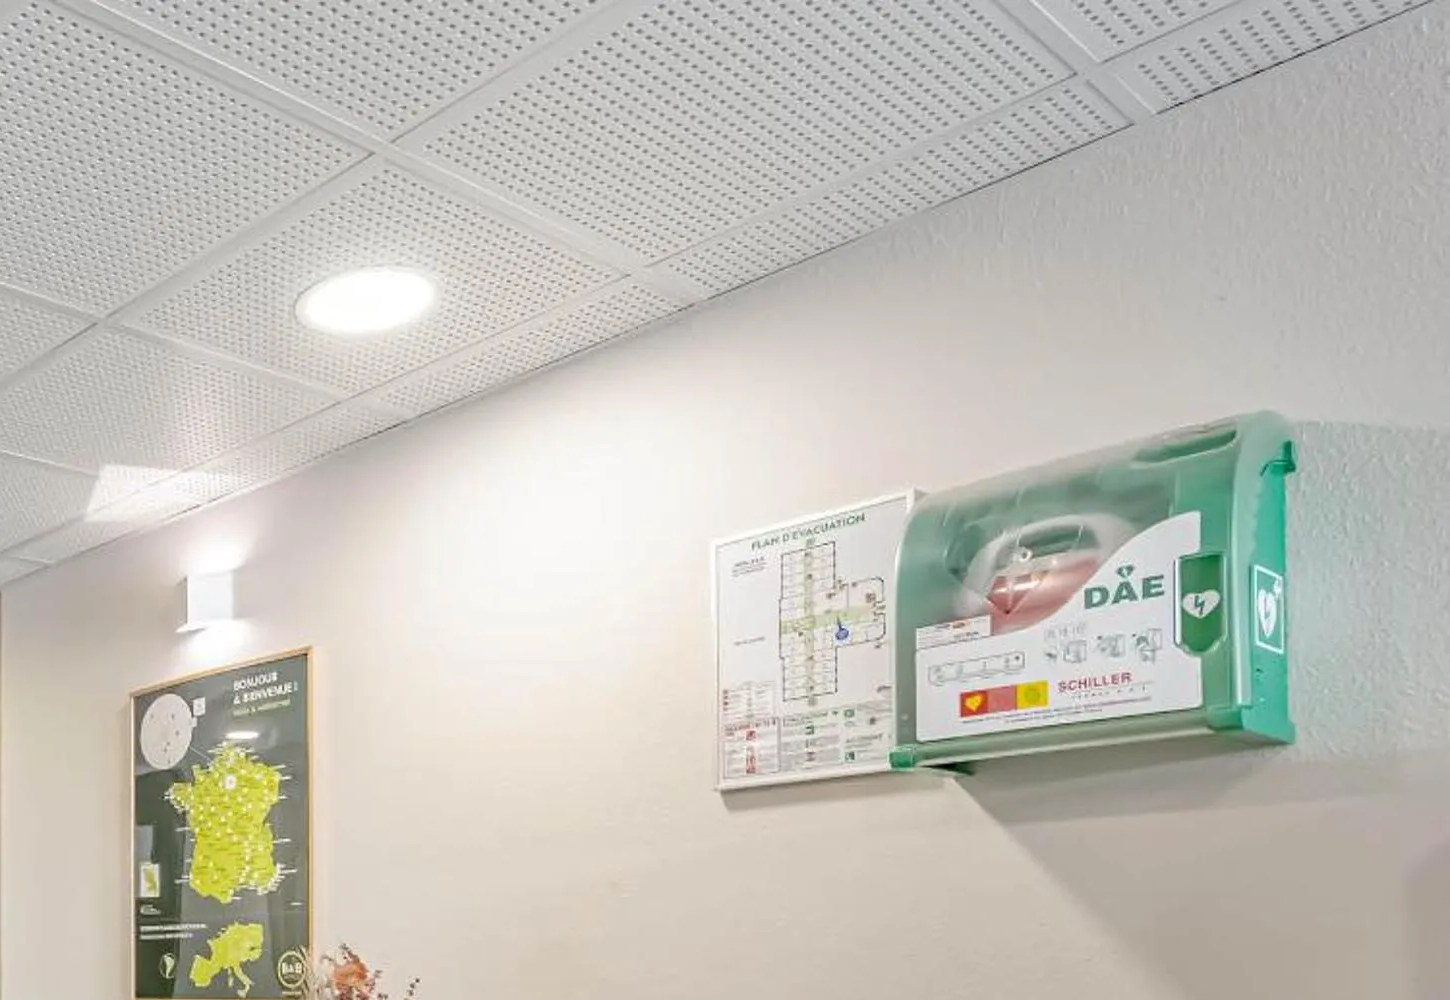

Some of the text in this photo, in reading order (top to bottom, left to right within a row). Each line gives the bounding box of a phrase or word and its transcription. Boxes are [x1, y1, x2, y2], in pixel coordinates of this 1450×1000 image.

[752, 535, 780, 550] PLAN
[1085, 575, 1165, 609] DAE
[233, 672, 278, 691] BONJOUR
[1058, 672, 1132, 693] SCHILLER
